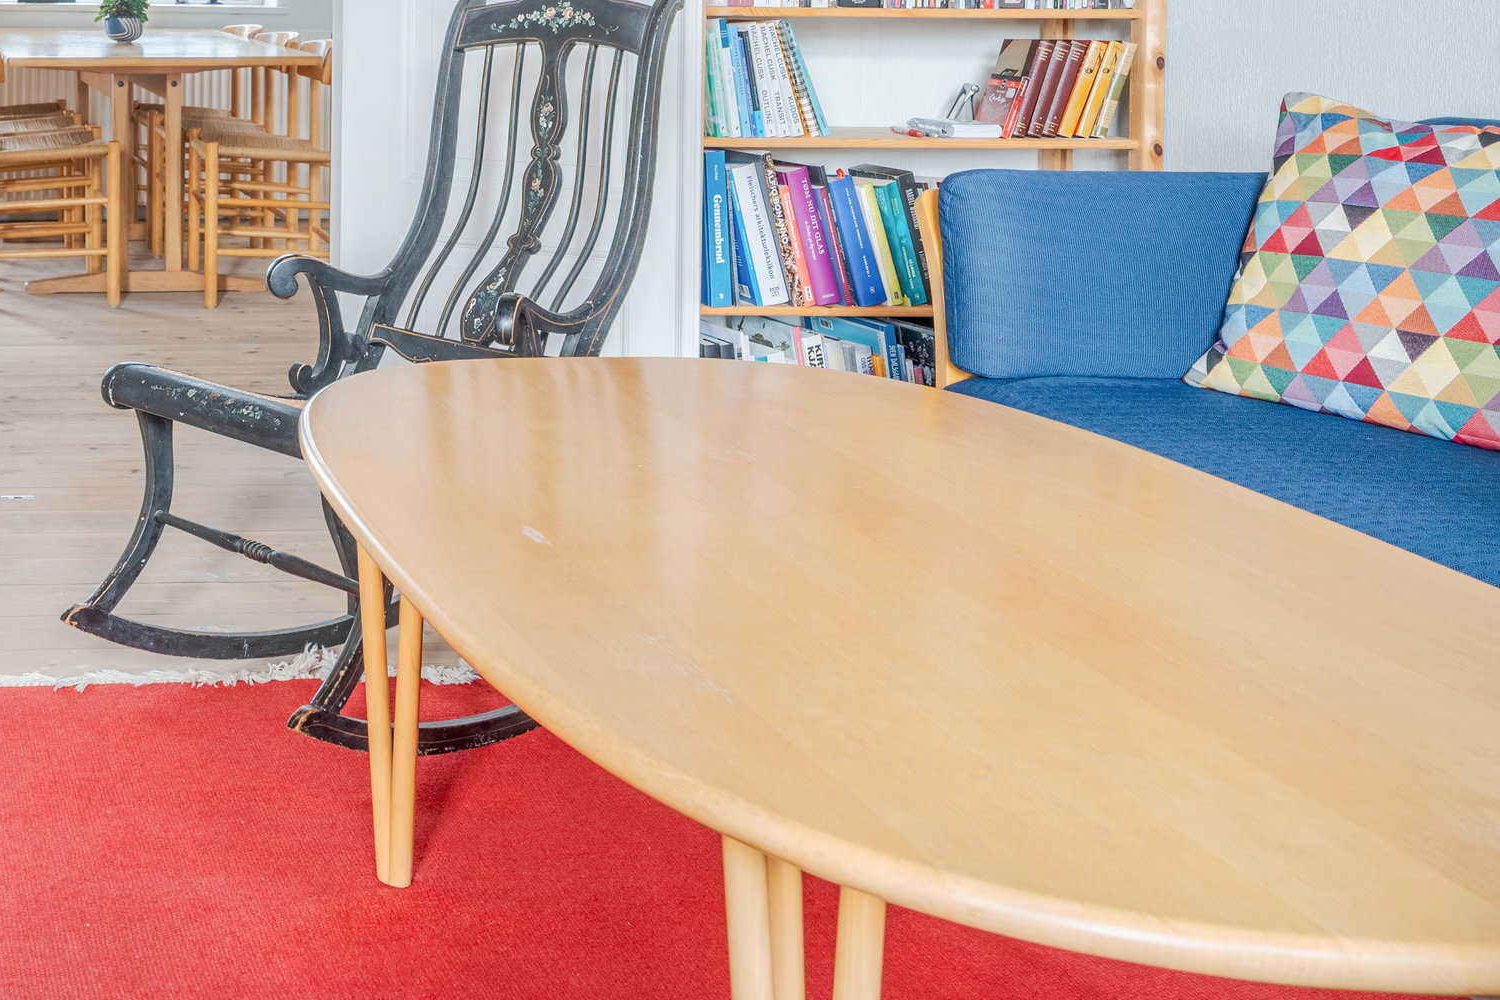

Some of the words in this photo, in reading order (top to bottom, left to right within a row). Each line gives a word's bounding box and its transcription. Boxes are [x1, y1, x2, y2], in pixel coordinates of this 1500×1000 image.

[750, 25, 759, 57] RACHEL
[755, 58, 764, 80] CUSK
[761, 90, 772, 124] OUTLINE
[760, 26, 770, 57] RACHEL
[767, 59, 776, 81] CUSK
[774, 91, 785, 125] TRANSIT
[768, 26, 780, 57] RACHEL
[777, 59, 787, 80] CUSK
[788, 96, 799, 124] KUDOS
[713, 194, 724, 264] Gennembrud
[747, 176, 759, 212] Fleischers
[755, 214, 775, 279] arkitekturleksikon
[767, 169, 777, 195] ALFIO
[773, 199, 788, 244] BONANNO
[802, 178, 810, 198] TØM
[810, 215, 818, 230] DIT
[814, 232, 824, 255] GLAS
[889, 345, 897, 357] SVEN
